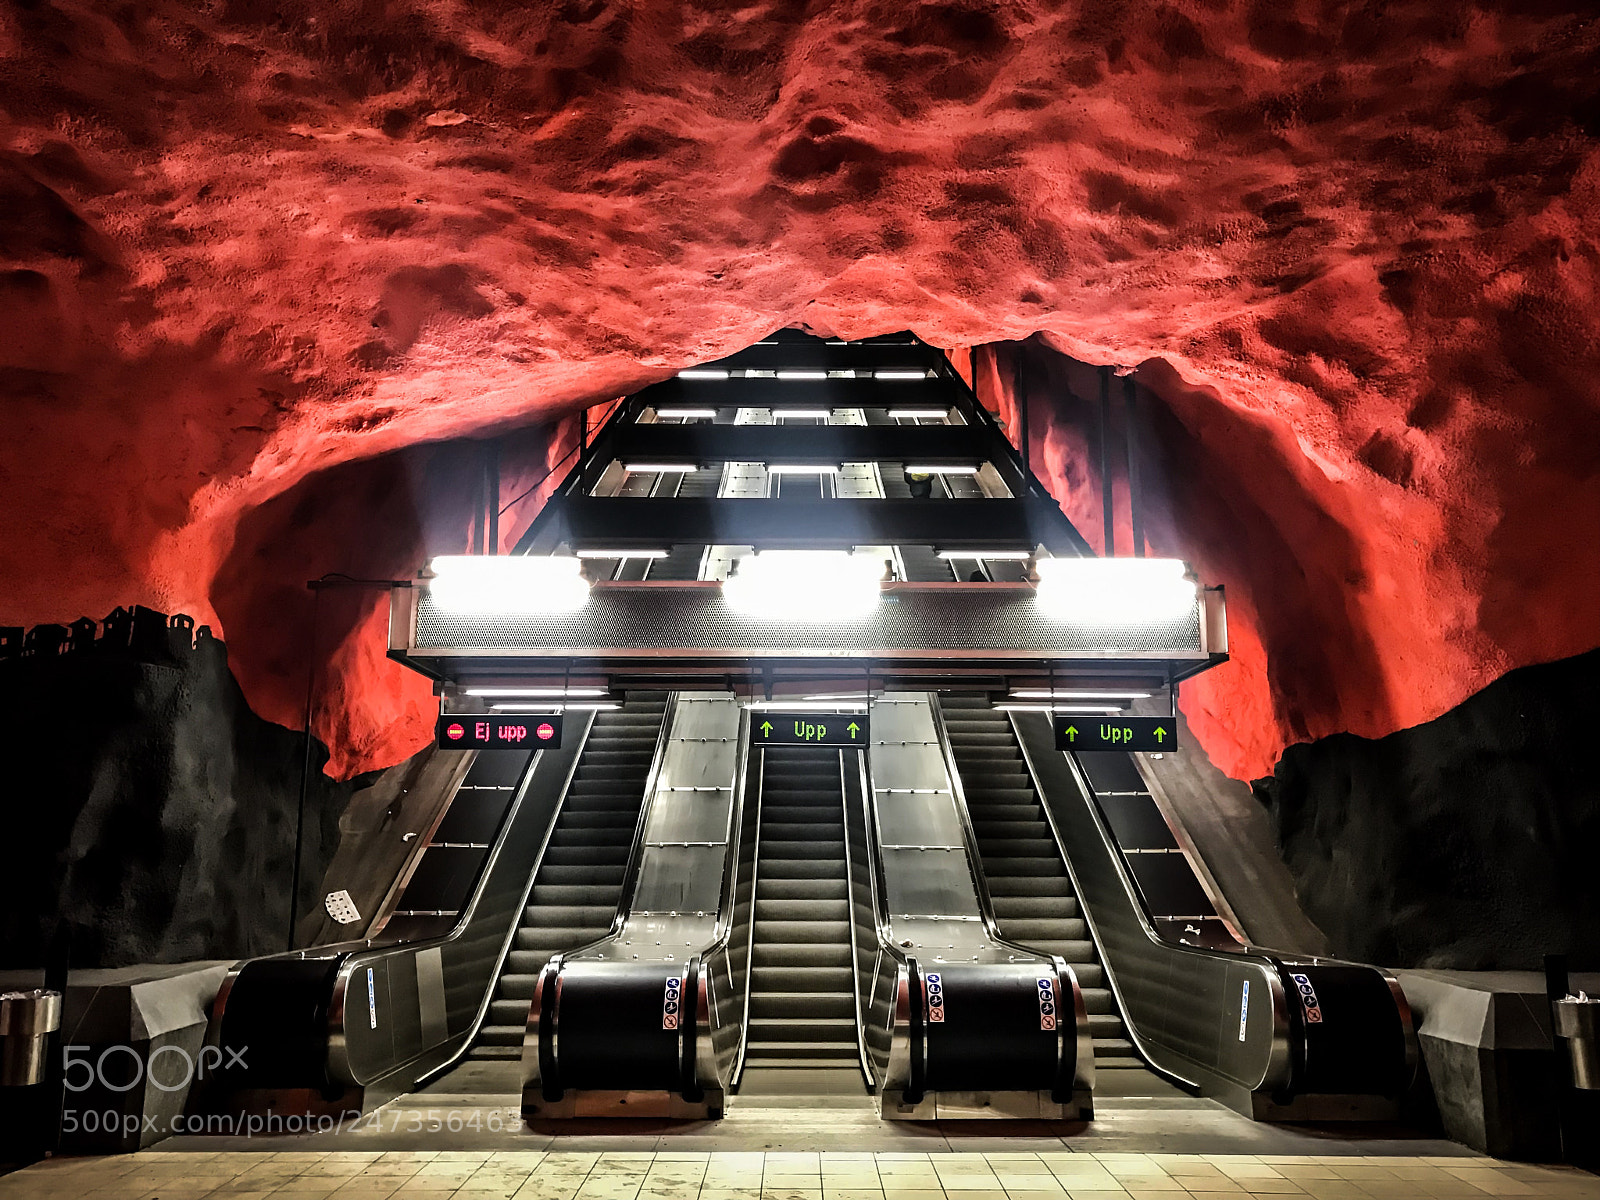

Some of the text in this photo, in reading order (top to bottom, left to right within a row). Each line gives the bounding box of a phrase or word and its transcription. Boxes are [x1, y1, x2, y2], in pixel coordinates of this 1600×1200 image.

[475, 722, 527, 743] Ej upp
[794, 721, 827, 741] Upp
[1100, 724, 1133, 744] Upp
